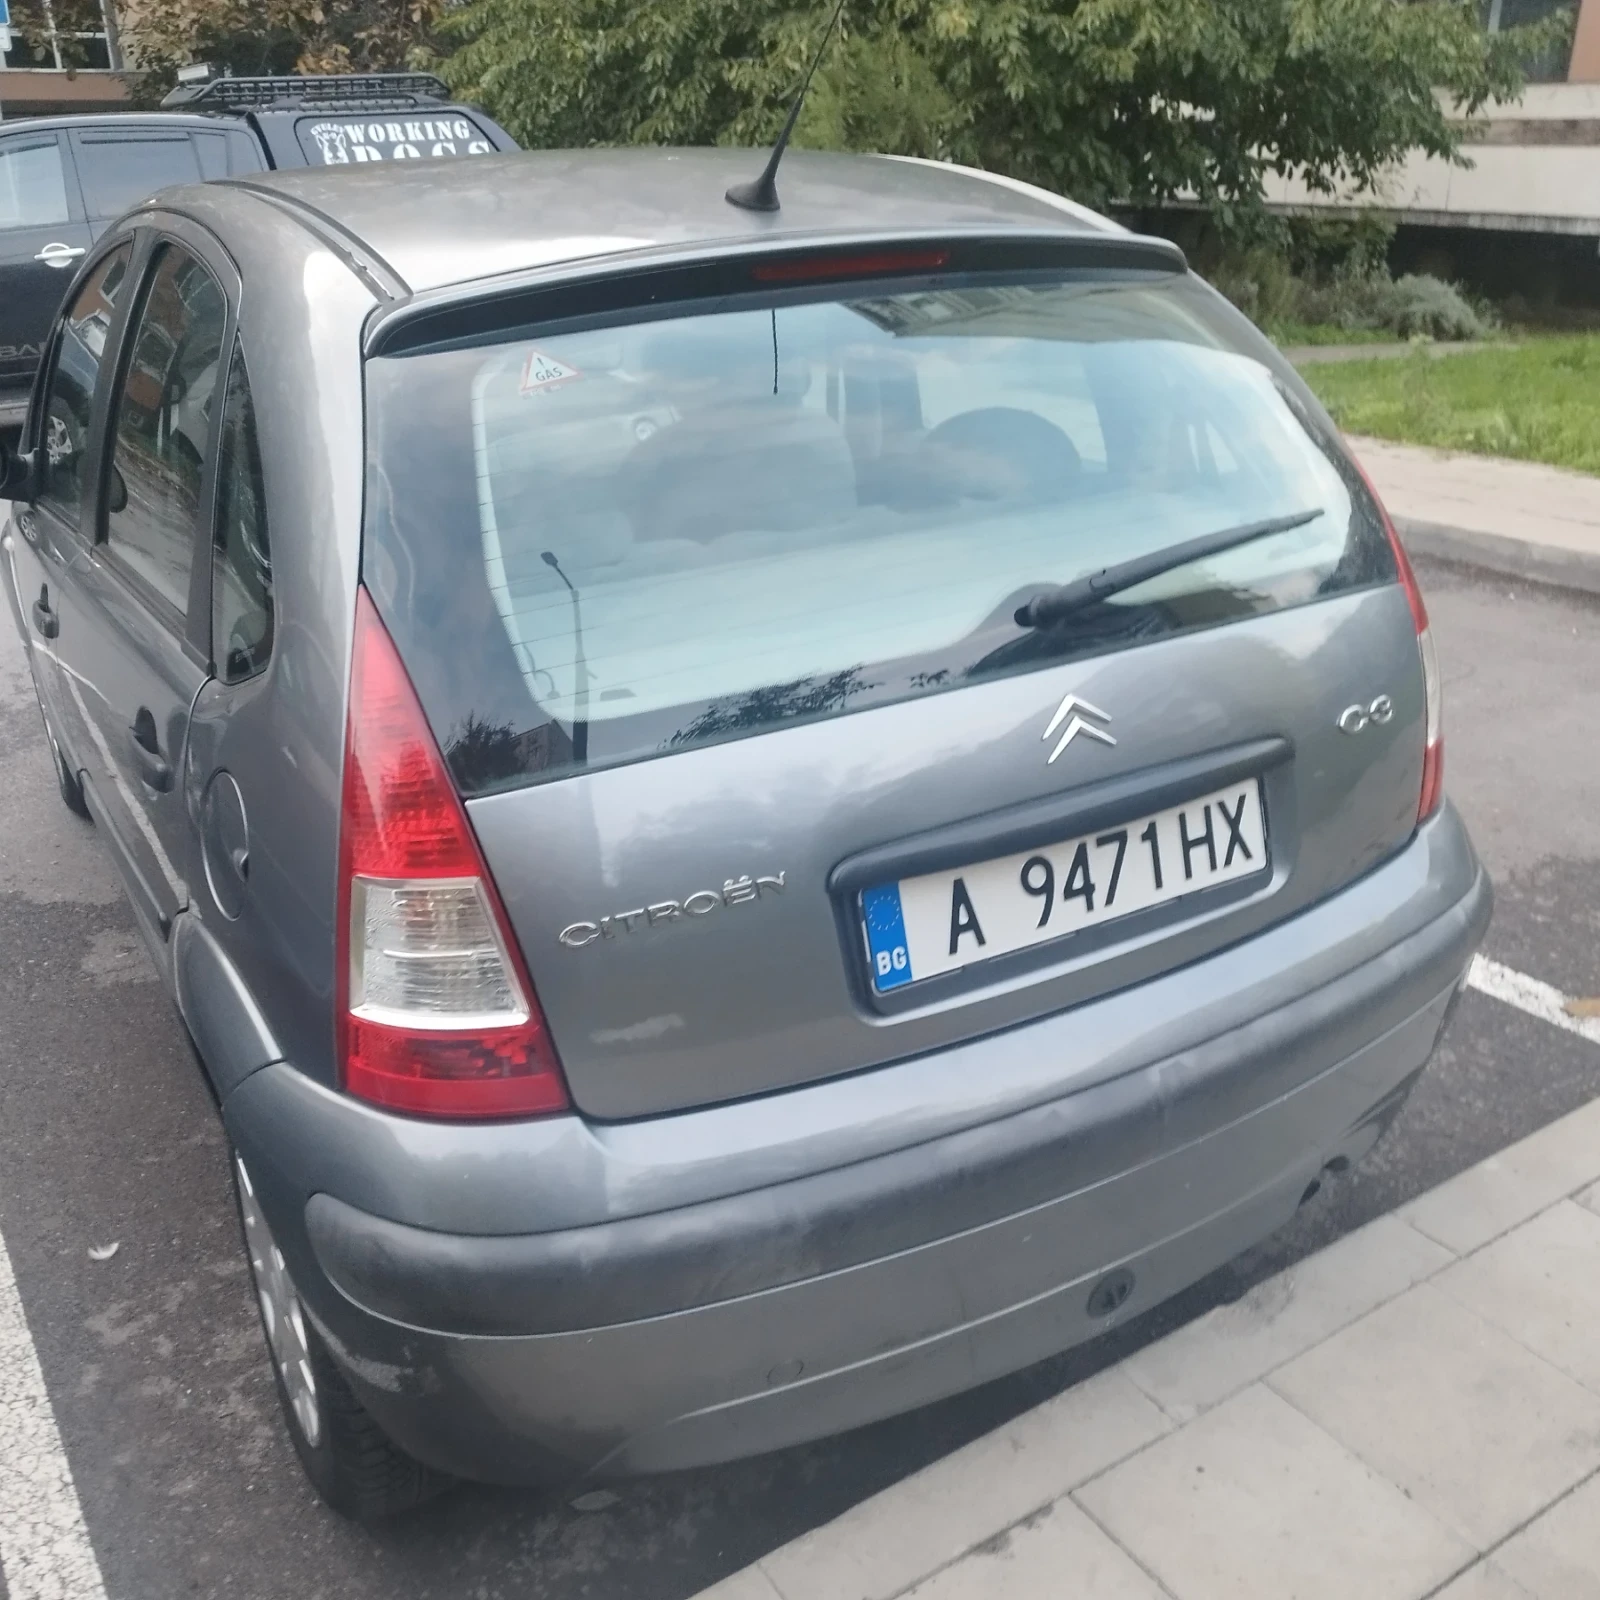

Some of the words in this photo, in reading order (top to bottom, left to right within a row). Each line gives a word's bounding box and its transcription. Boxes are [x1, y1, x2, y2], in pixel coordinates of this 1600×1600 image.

[344, 120, 471, 144] WORKING
[535, 367, 562, 382] GAS
[948, 878, 987, 955] A
[1020, 821, 1163, 929] 9471
[1178, 794, 1253, 880] HX
[558, 870, 786, 947] CITROËN
[876, 946, 908, 976] BG
